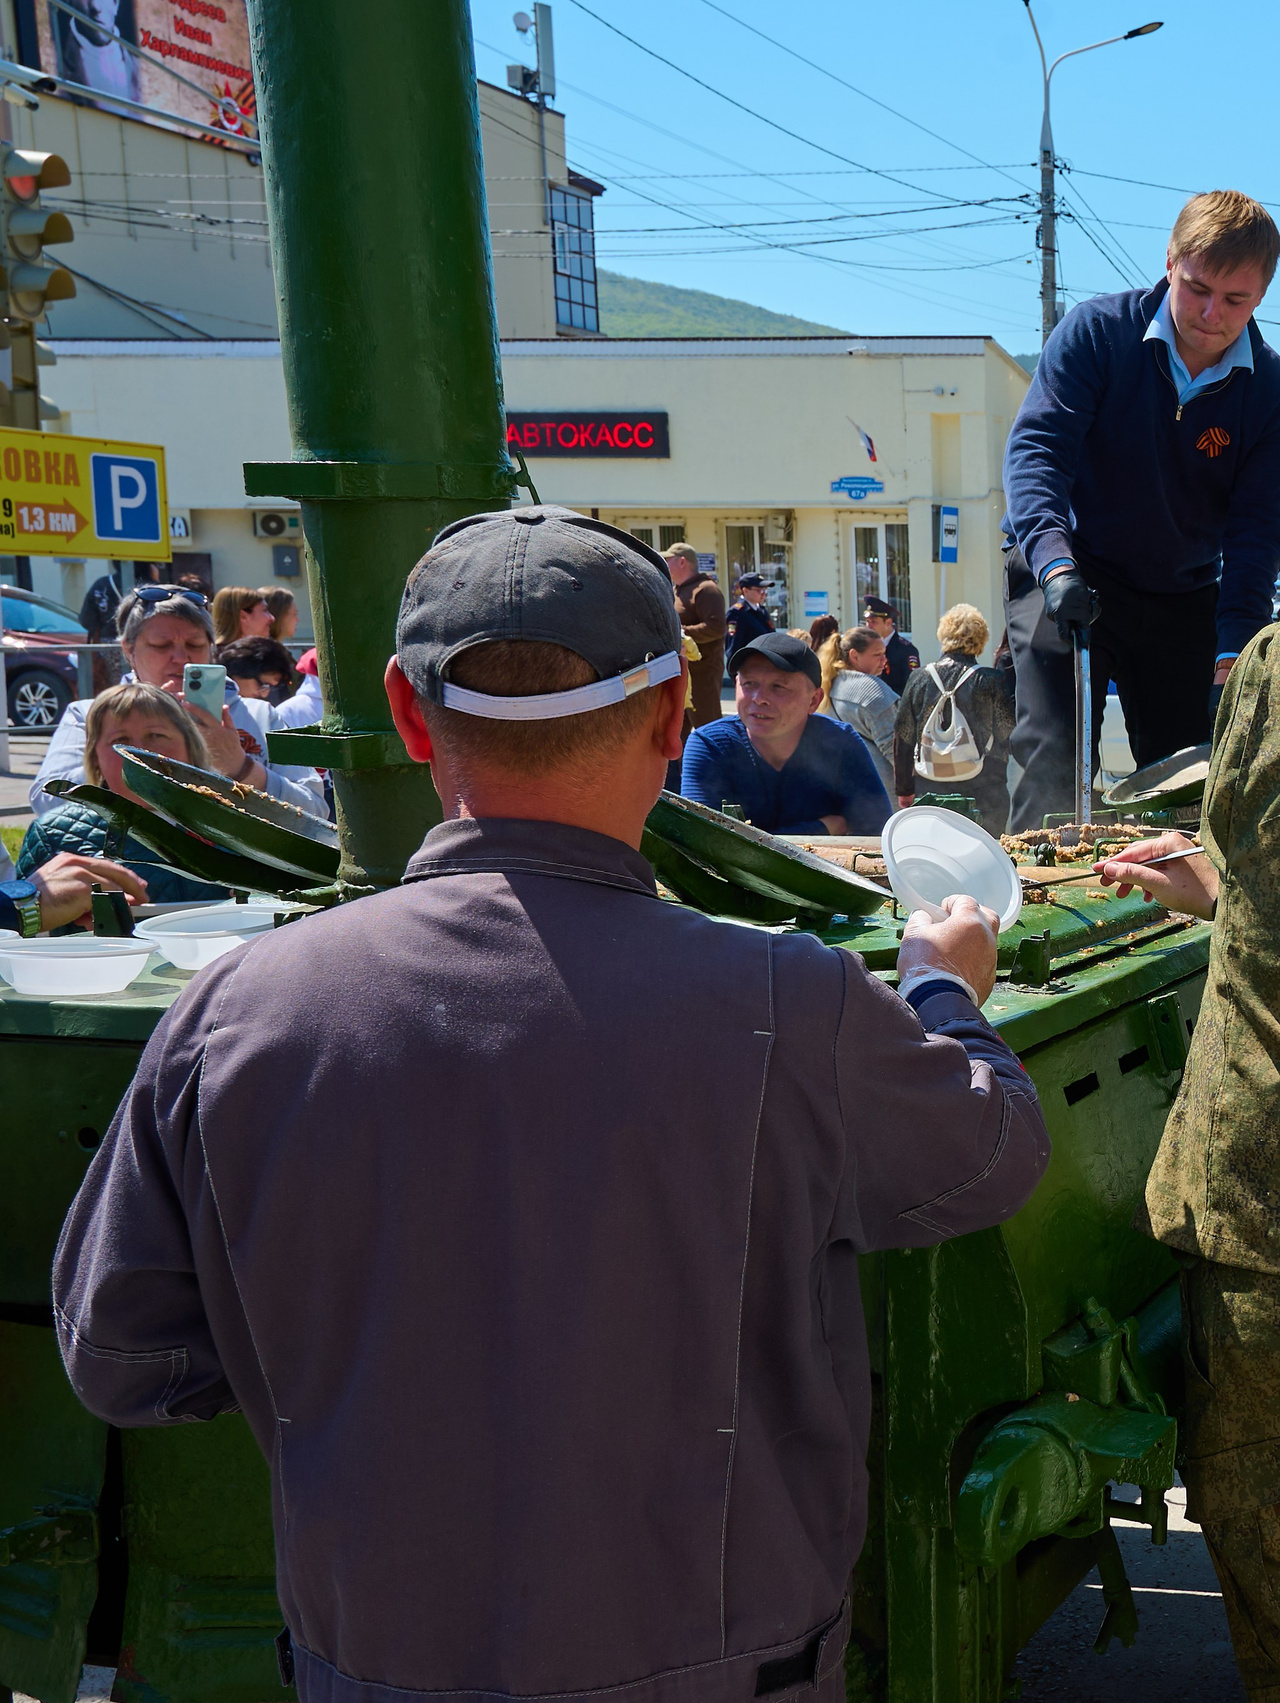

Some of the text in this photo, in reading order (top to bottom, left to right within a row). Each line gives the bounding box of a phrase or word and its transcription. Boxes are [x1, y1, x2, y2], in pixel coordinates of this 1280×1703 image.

[173, 15, 212, 46] Иван
[507, 422, 654, 448] АВТОКАСС
[0, 447, 81, 487] ОВКА
[2, 498, 12, 518] 9
[19, 506, 45, 532] 1,3
